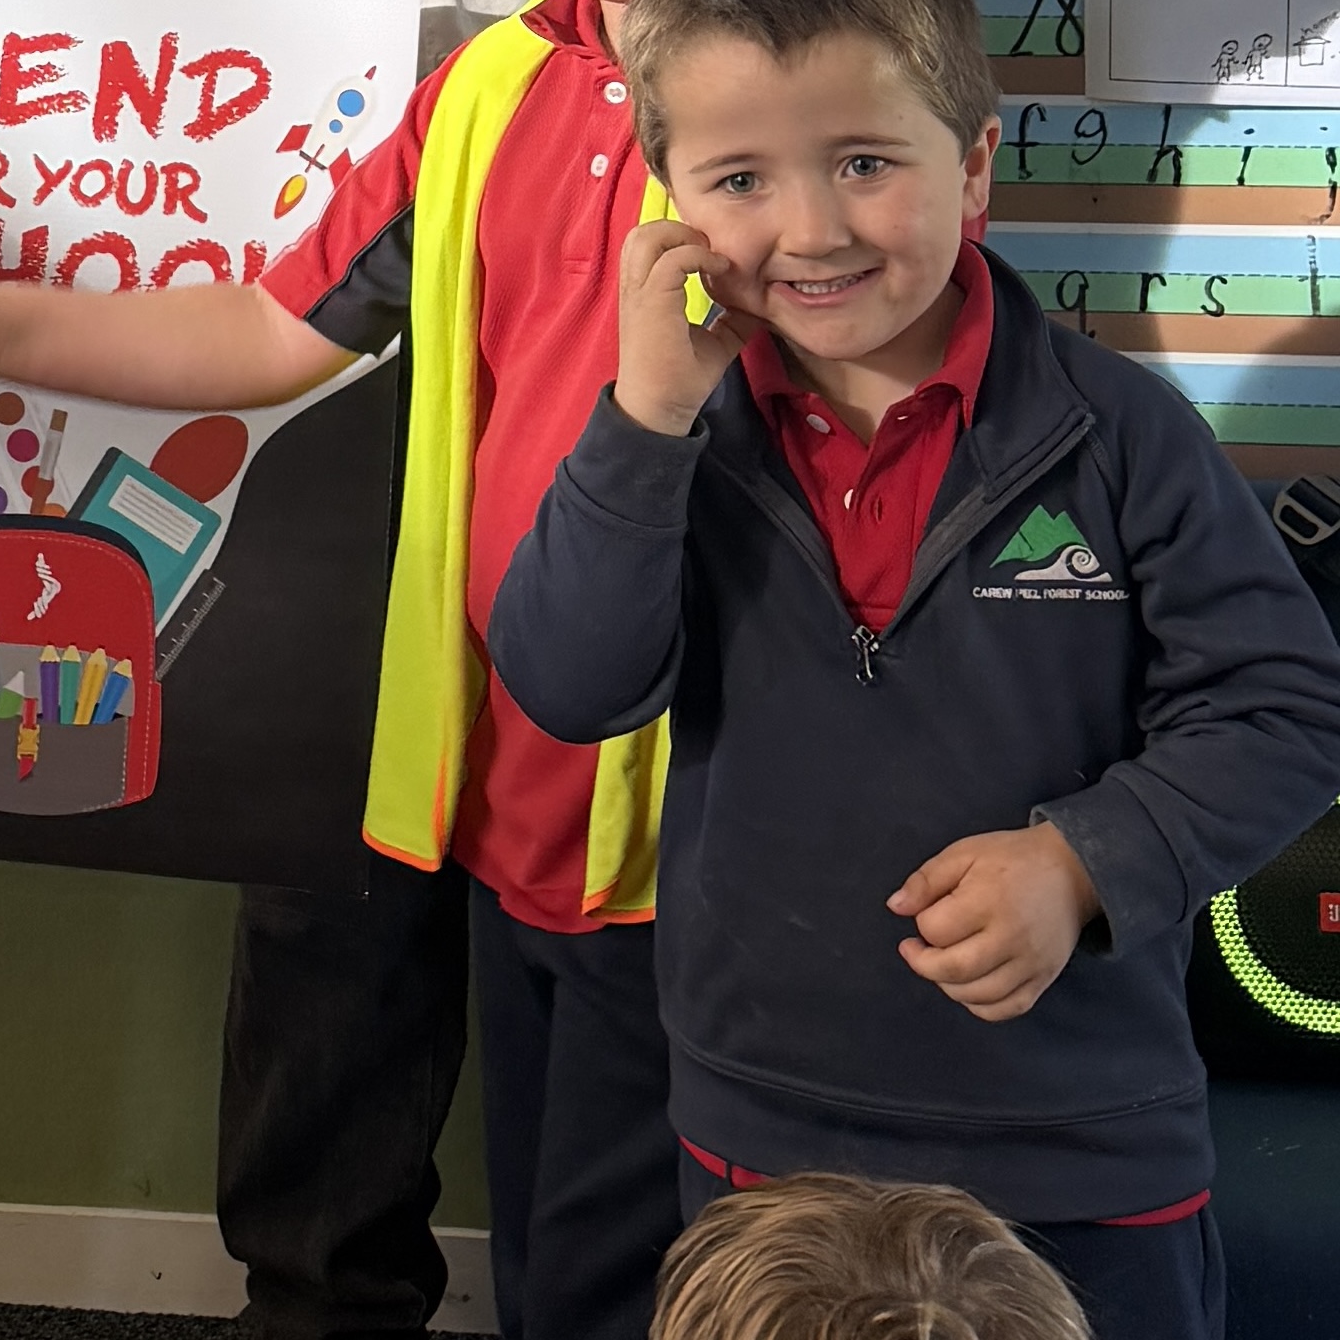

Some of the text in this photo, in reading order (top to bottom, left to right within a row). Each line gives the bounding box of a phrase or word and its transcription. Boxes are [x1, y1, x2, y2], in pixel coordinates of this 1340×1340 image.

[1006, 102, 1047, 180] f
[1147, 103, 1182, 187] h
[1236, 128, 1255, 186] i
[31, 153, 208, 224] YOUR
[1140, 273, 1167, 313] r
[1200, 275, 1227, 317] s
[1085, 590, 1130, 601] SCHOOL
